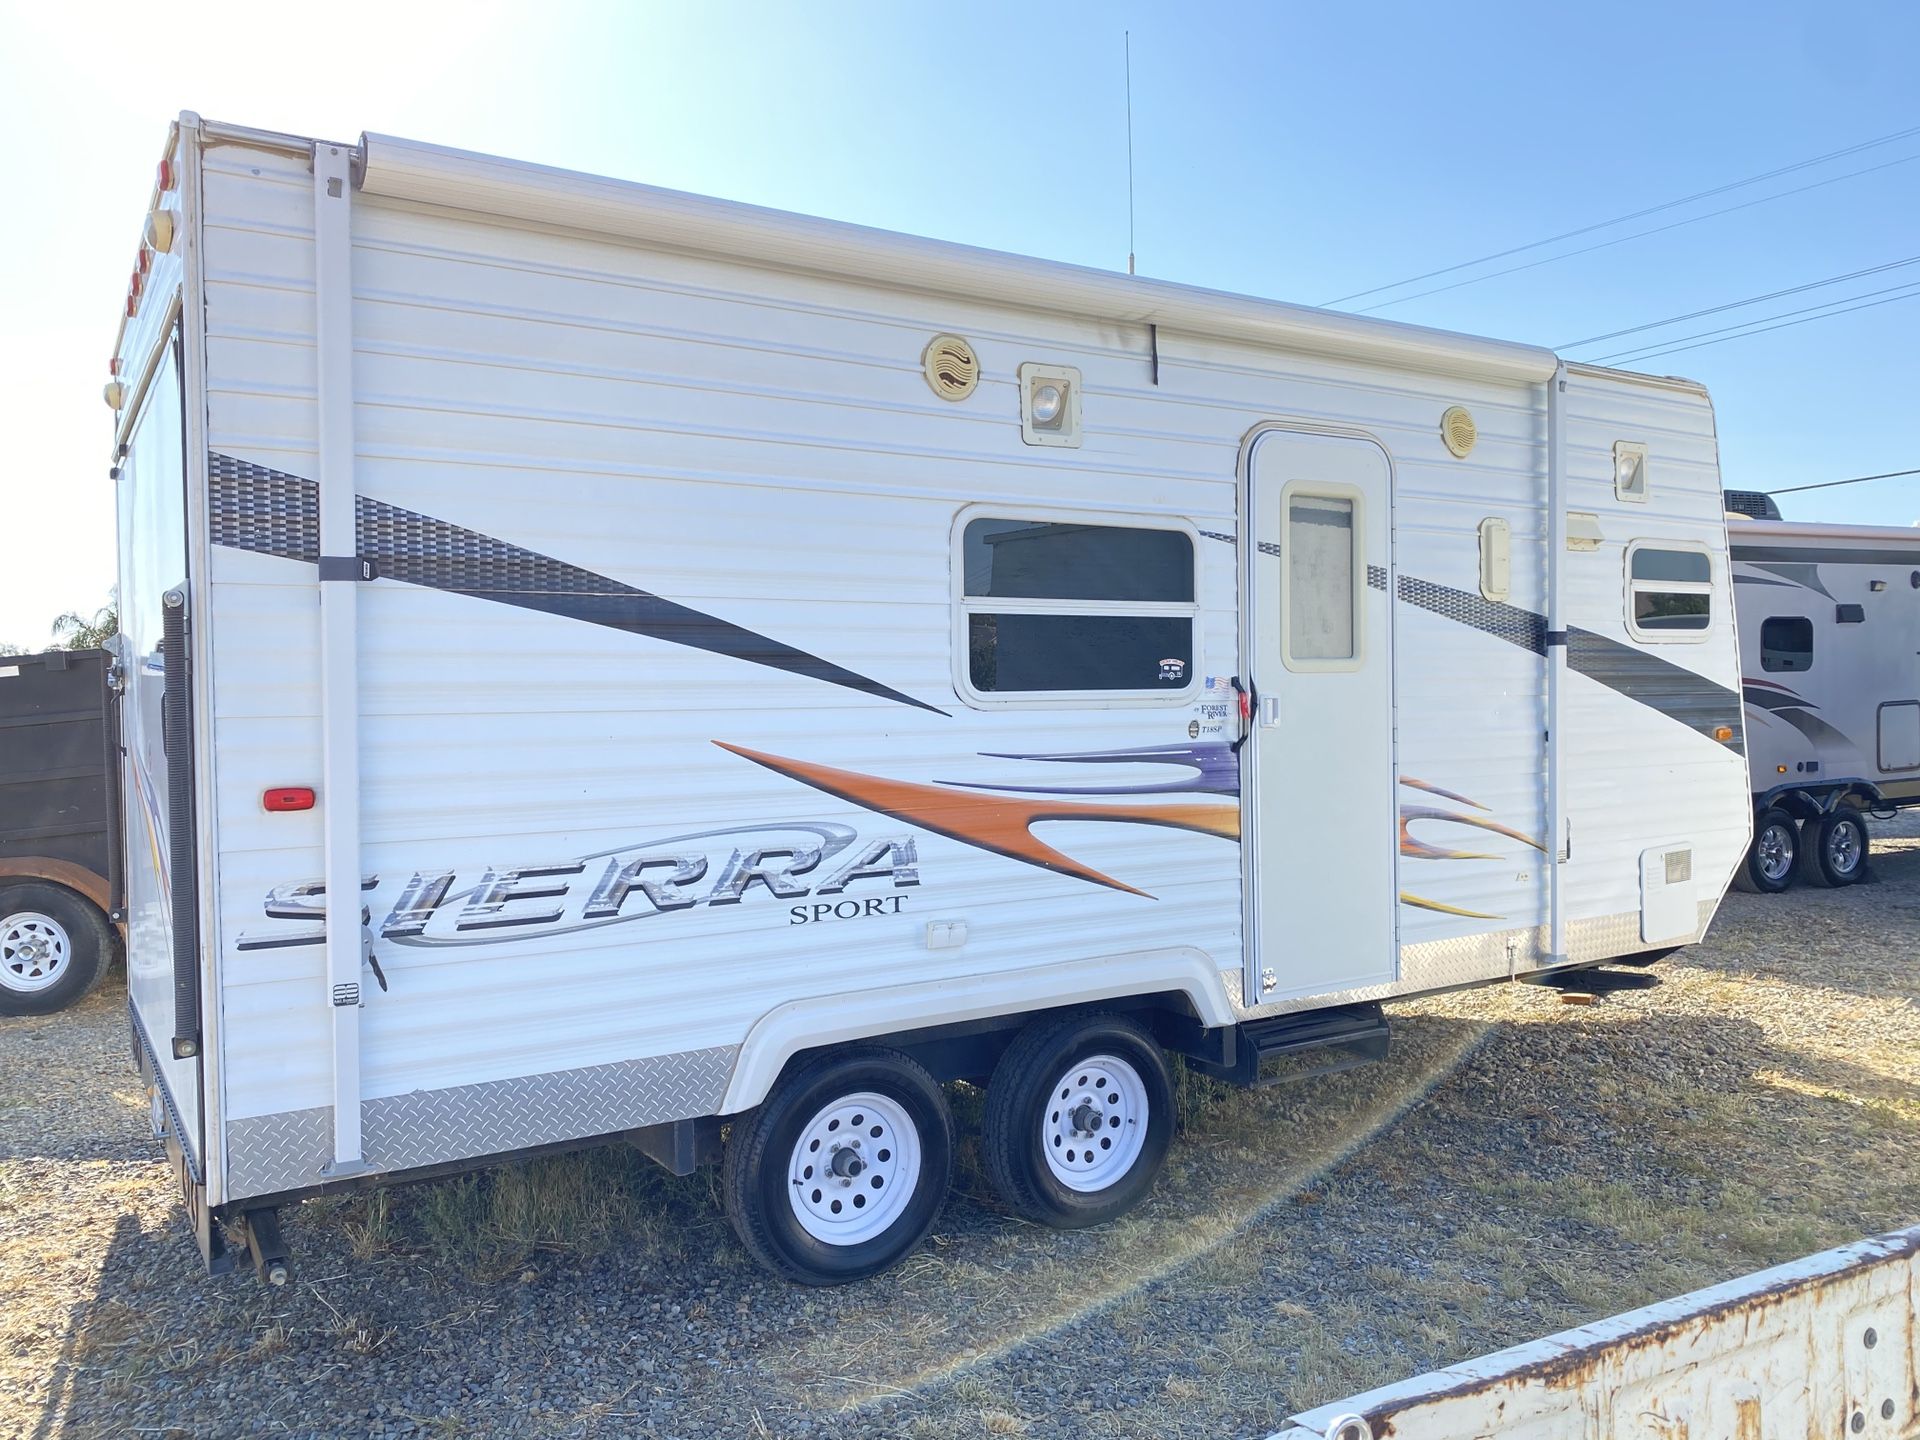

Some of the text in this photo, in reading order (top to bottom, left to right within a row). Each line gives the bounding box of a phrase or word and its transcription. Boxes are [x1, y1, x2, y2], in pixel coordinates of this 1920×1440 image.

[1201, 704, 1228, 714] FOREST
[235, 834, 921, 951] SIERRA
[790, 895, 909, 926] SPORT
